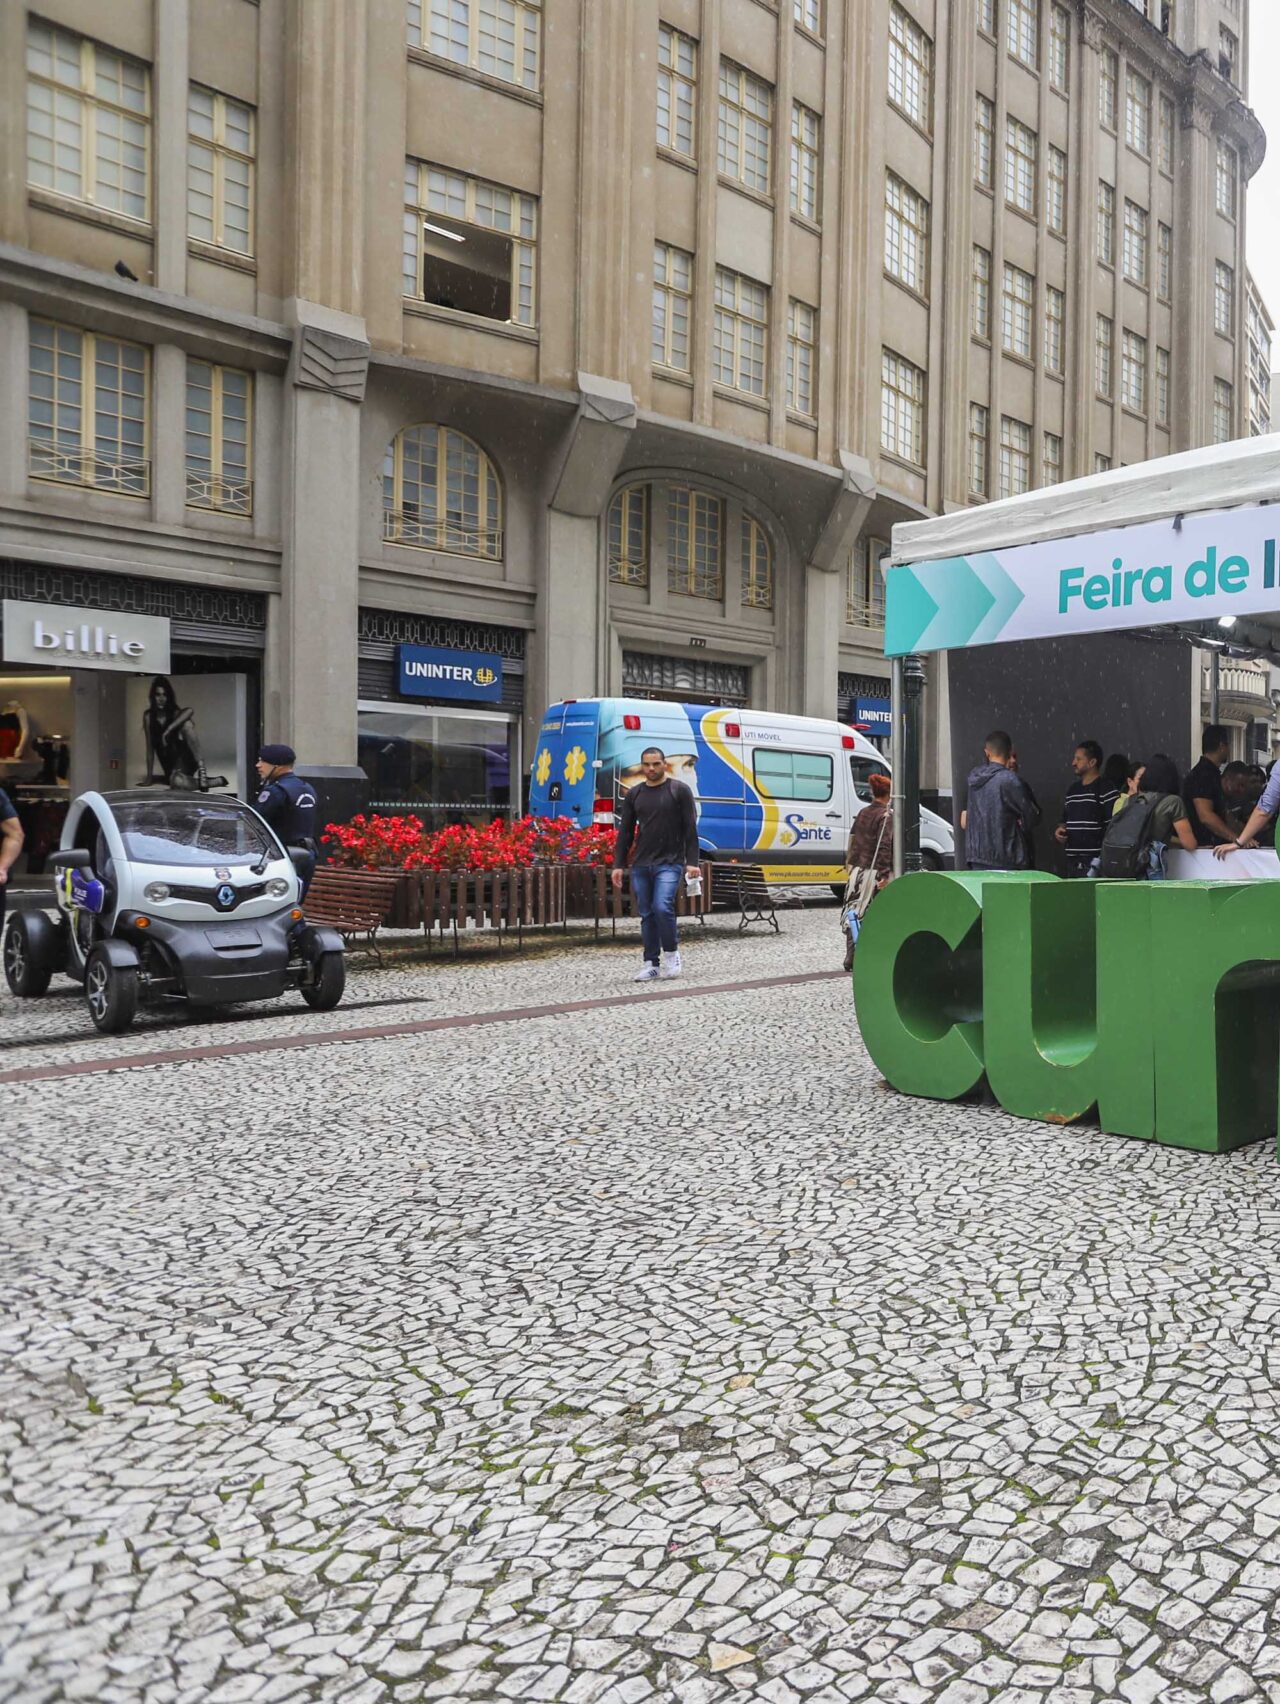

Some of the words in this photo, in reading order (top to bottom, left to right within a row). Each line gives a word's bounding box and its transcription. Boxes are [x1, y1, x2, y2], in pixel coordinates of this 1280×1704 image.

[1058, 557, 1173, 614] Feira
[1184, 545, 1250, 598] de
[34, 620, 145, 657] billie
[405, 661, 473, 682] UNINTER
[858, 709, 892, 723] UNINTE
[744, 731, 756, 739] UTI
